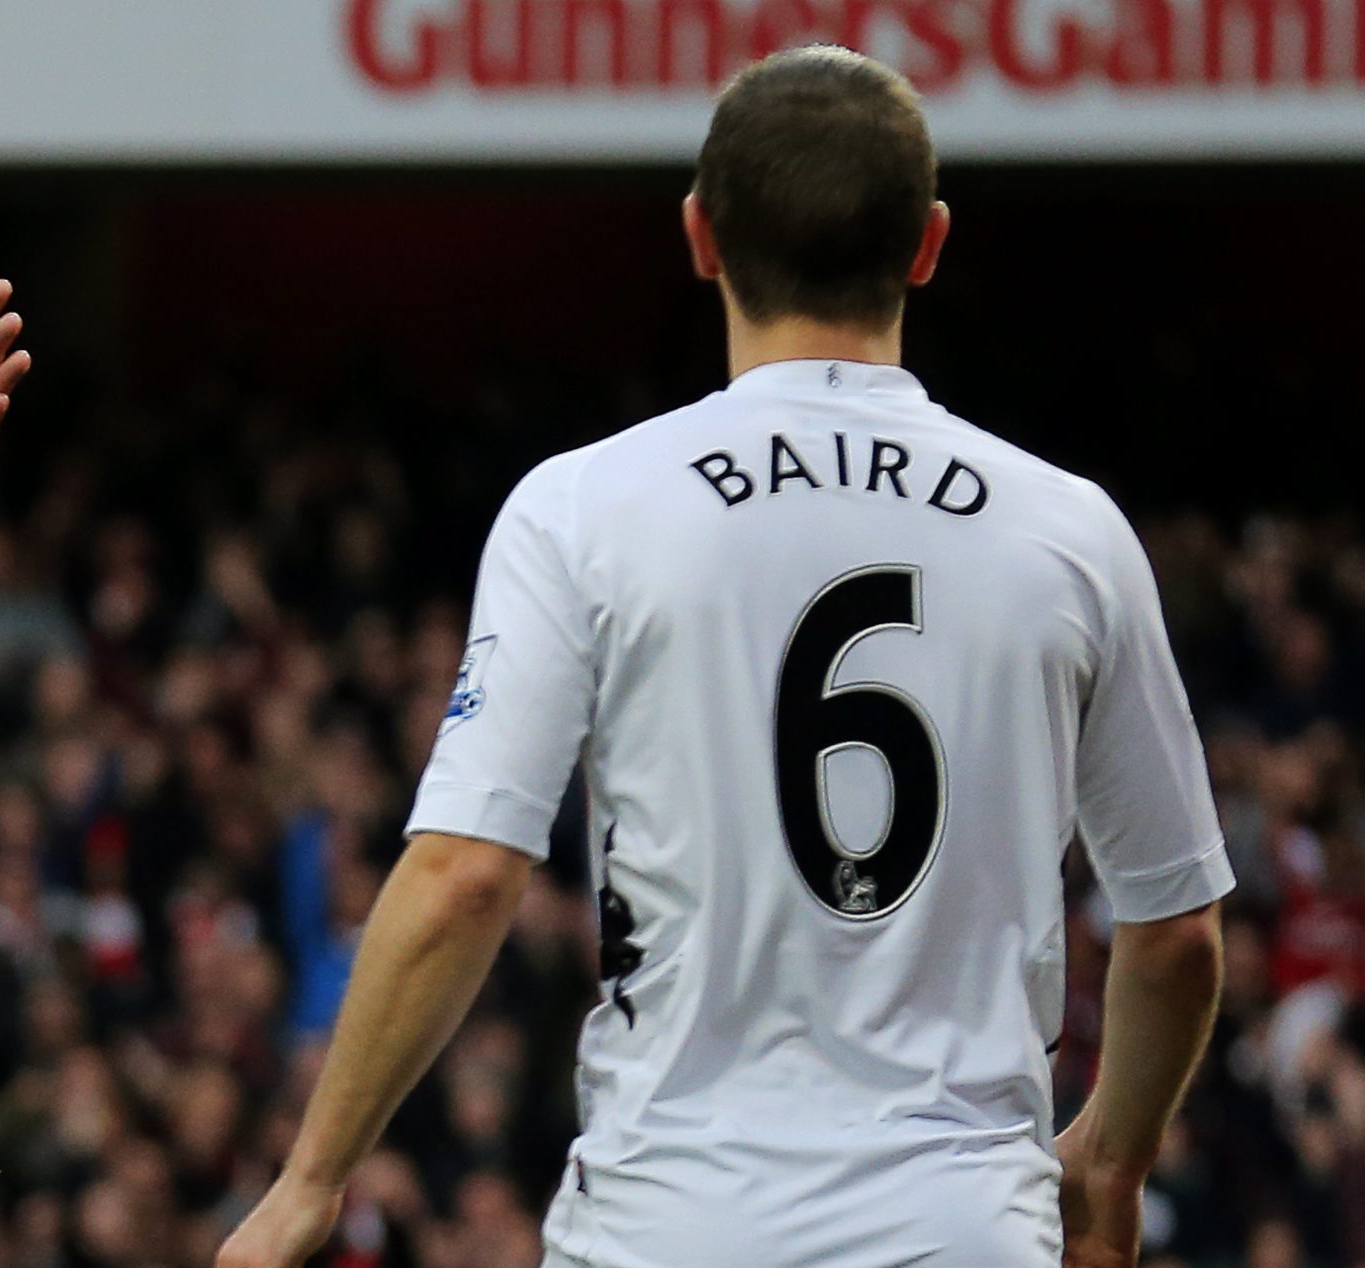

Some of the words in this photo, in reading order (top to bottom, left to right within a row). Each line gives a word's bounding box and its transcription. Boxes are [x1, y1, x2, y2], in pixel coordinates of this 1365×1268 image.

[345, 0, 1365, 92] GunnersGam
[689, 431, 992, 518] BAIRD
[773, 562, 949, 921] 6
